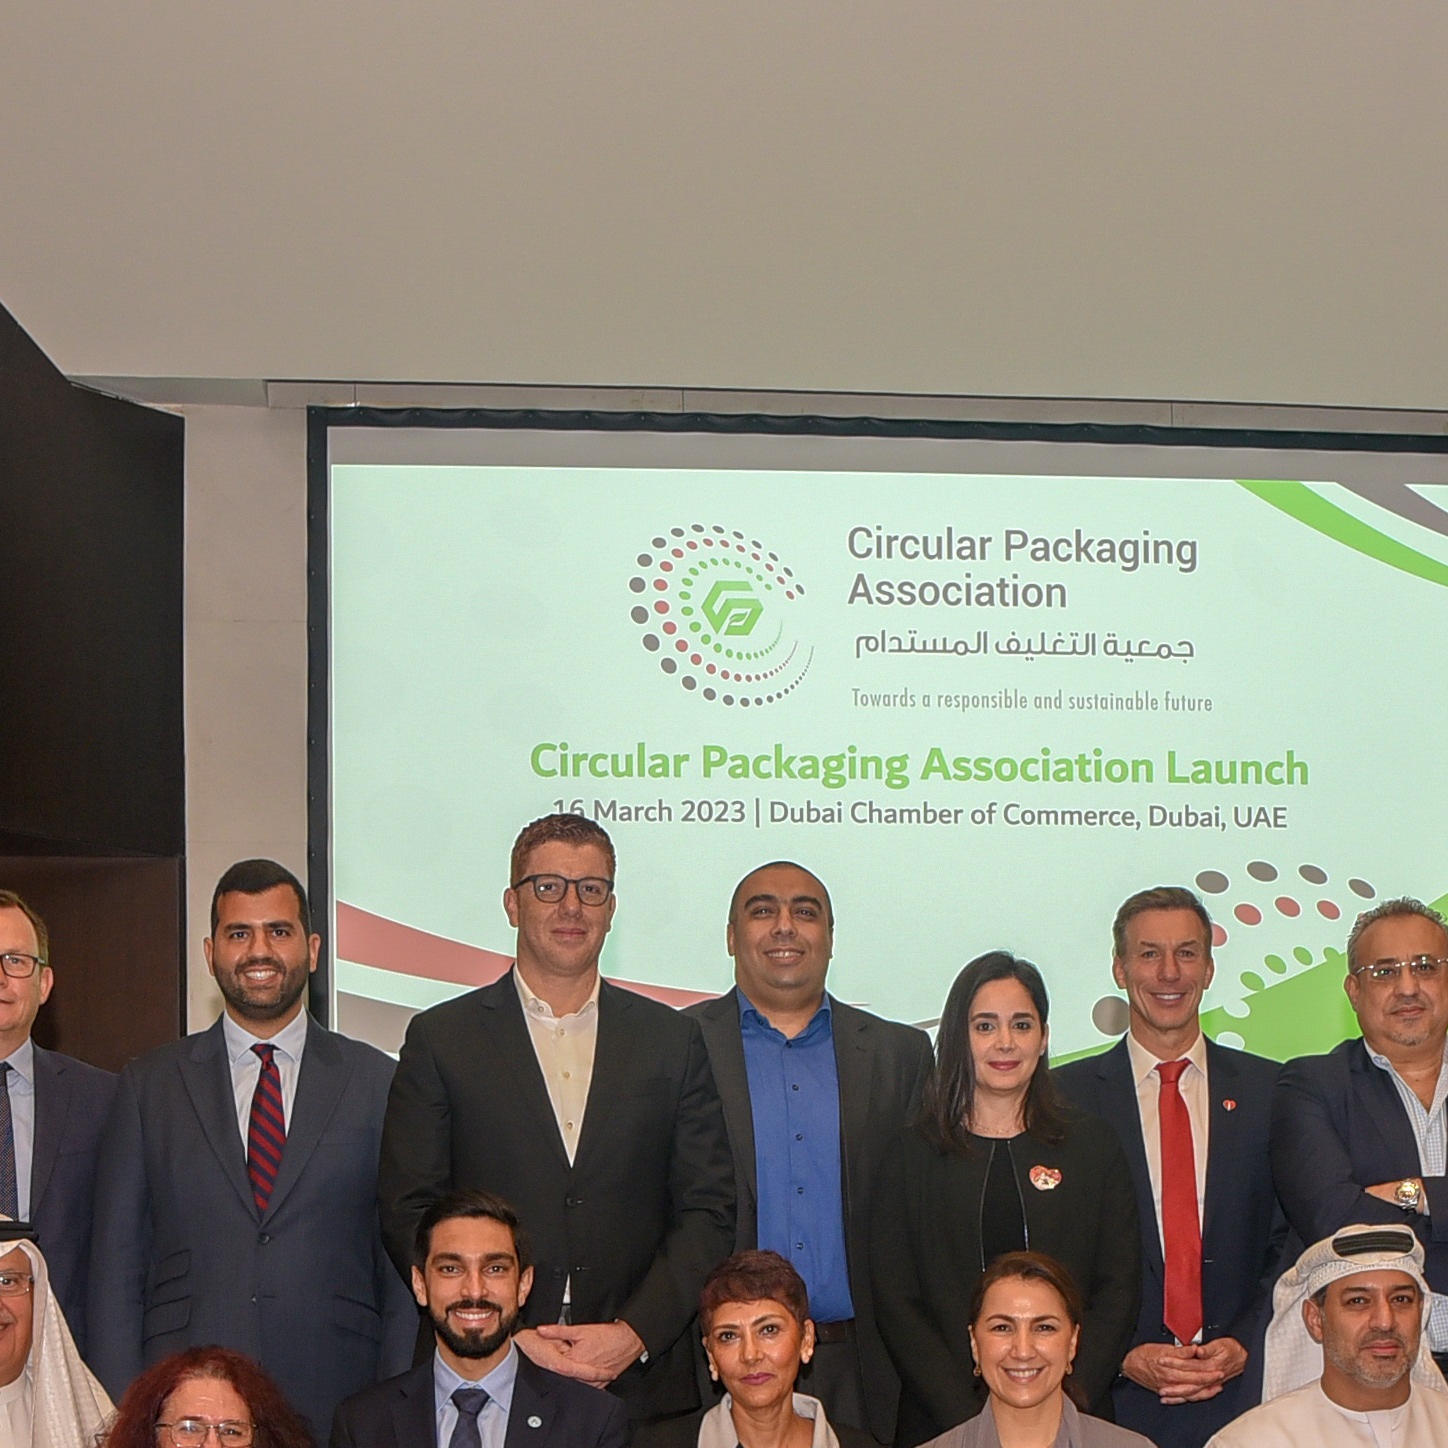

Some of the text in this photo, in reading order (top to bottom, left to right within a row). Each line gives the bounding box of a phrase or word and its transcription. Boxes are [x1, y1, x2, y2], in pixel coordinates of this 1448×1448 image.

[848, 525, 1197, 573] Circular Packaging
[847, 572, 1067, 608] Association
[855, 629, 1194, 664] جمعية التغليف المستدام
[851, 687, 1213, 712] Towards a responsible and sustainable future
[530, 741, 1309, 790] Circular Packaging Association Launch
[592, 799, 673, 823] March
[681, 800, 746, 823] 2023
[770, 800, 842, 824] Dubai
[850, 801, 964, 825] Chamber
[970, 802, 998, 825] of
[1003, 803, 1141, 831] Commerce,
[1149, 804, 1227, 832] Dubai,
[1234, 806, 1288, 828] UAE
